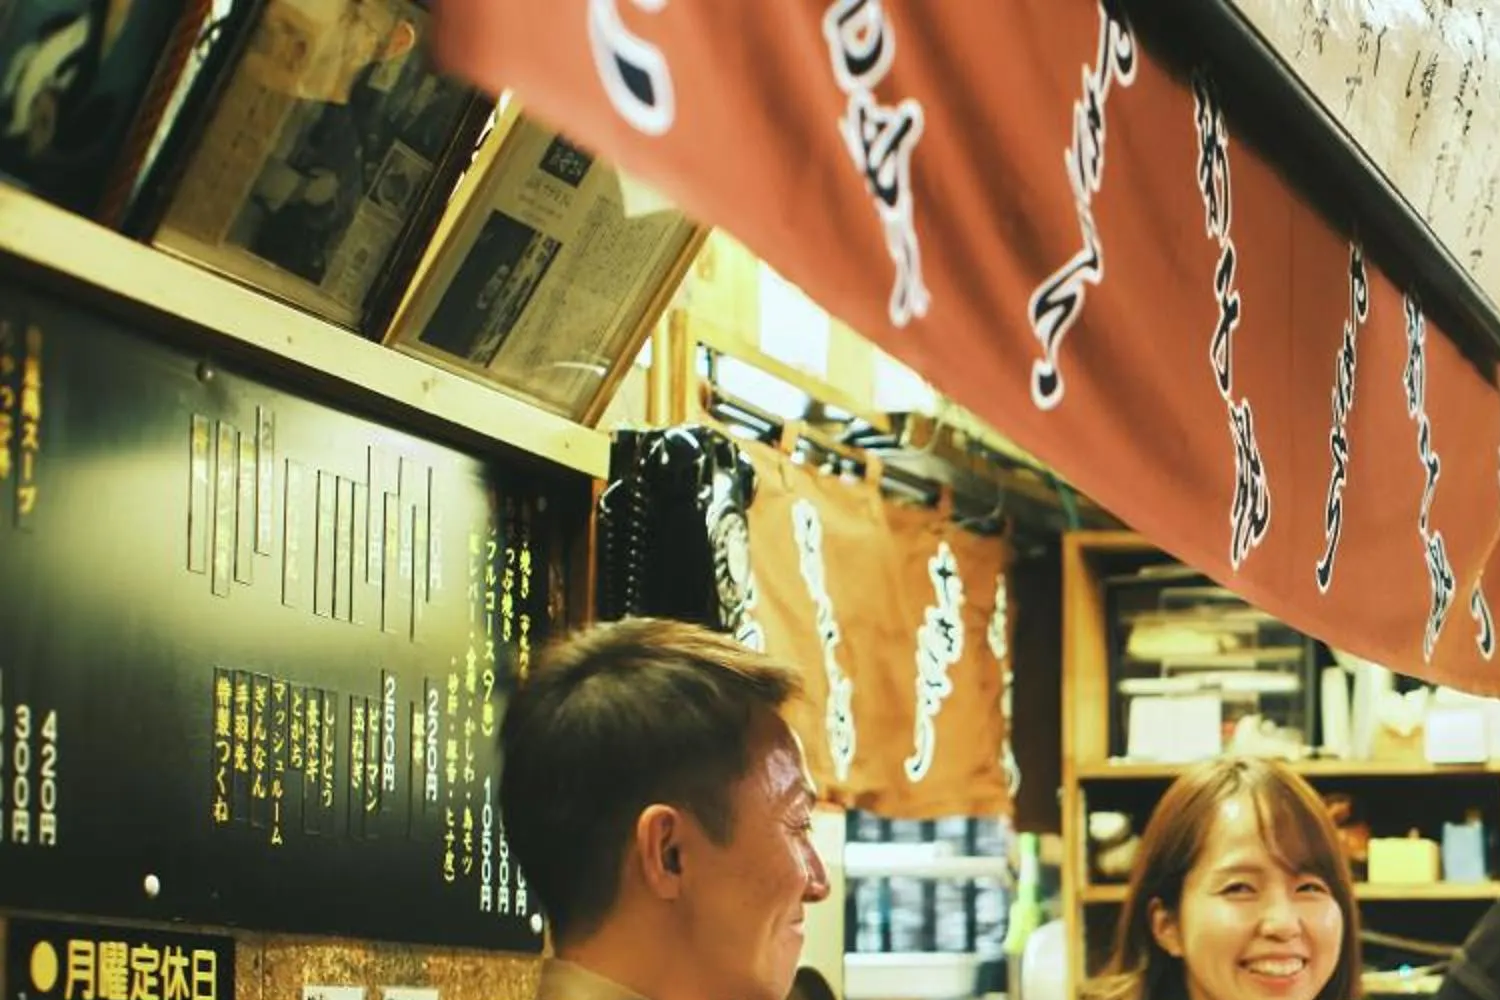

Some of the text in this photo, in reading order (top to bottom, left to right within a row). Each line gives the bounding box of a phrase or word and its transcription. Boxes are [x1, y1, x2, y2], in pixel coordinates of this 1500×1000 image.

[11, 704, 31, 844] 300円
[39, 709, 58, 845] 420円
[252, 686, 267, 798] ぎんなん
[271, 683, 285, 845] マッシュルーム
[322, 700, 334, 807] ししとう
[365, 707, 378, 811] ピーマン
[383, 676, 395, 792] 250円
[426, 689, 439, 802] 220円
[480, 775, 493, 912] 1050円
